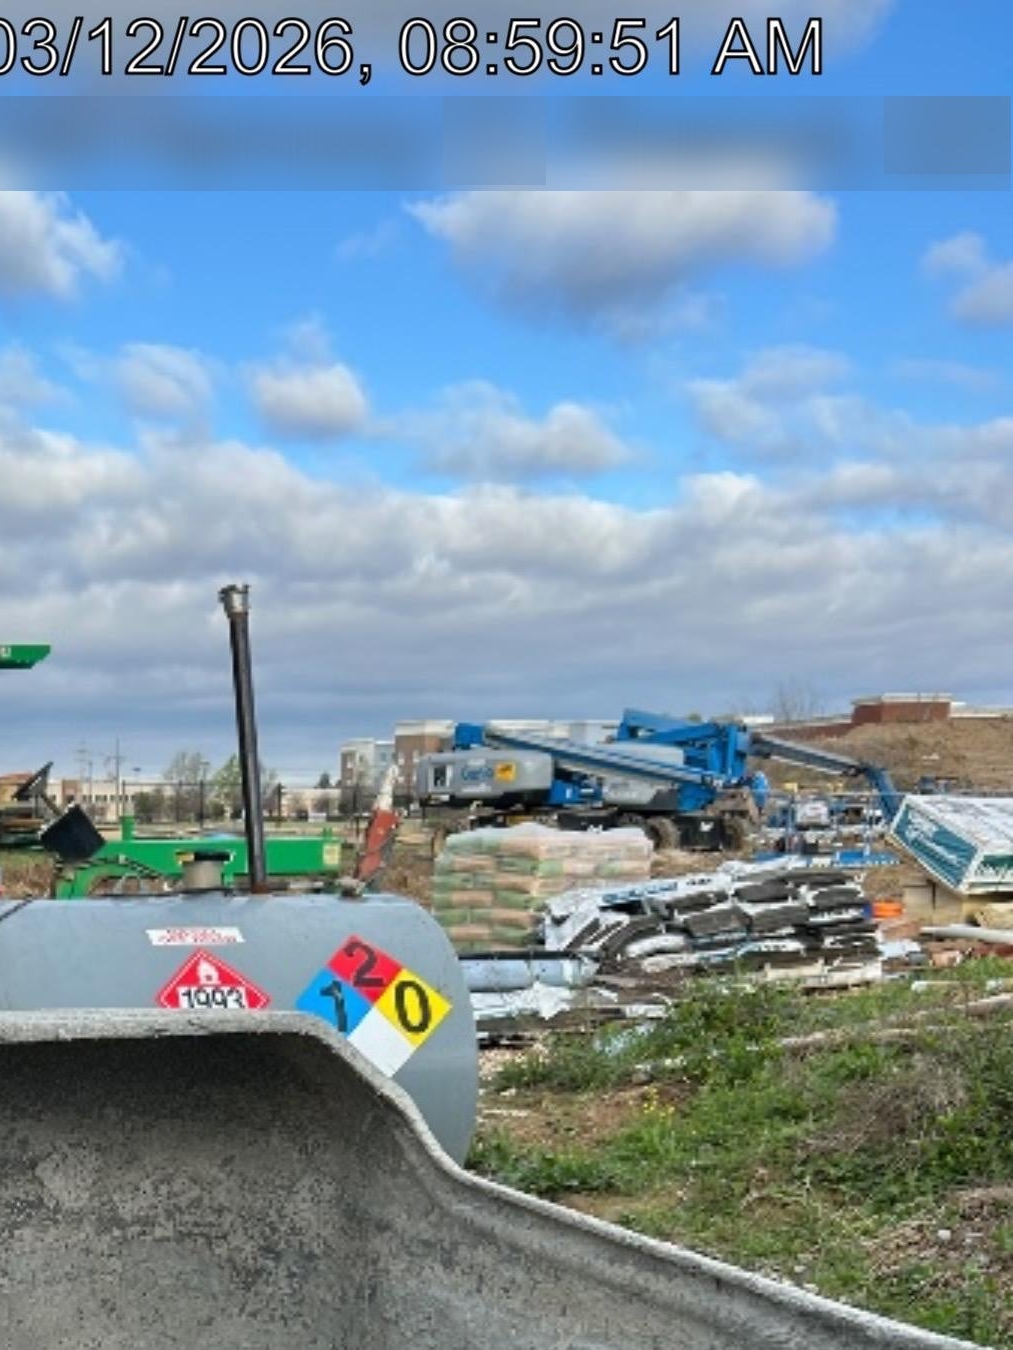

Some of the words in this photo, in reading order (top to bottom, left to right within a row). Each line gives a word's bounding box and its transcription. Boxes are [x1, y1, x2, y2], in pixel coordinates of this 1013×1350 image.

[342, 941, 385, 988] 2
[319, 980, 349, 1033] 1
[394, 980, 432, 1034] 0
